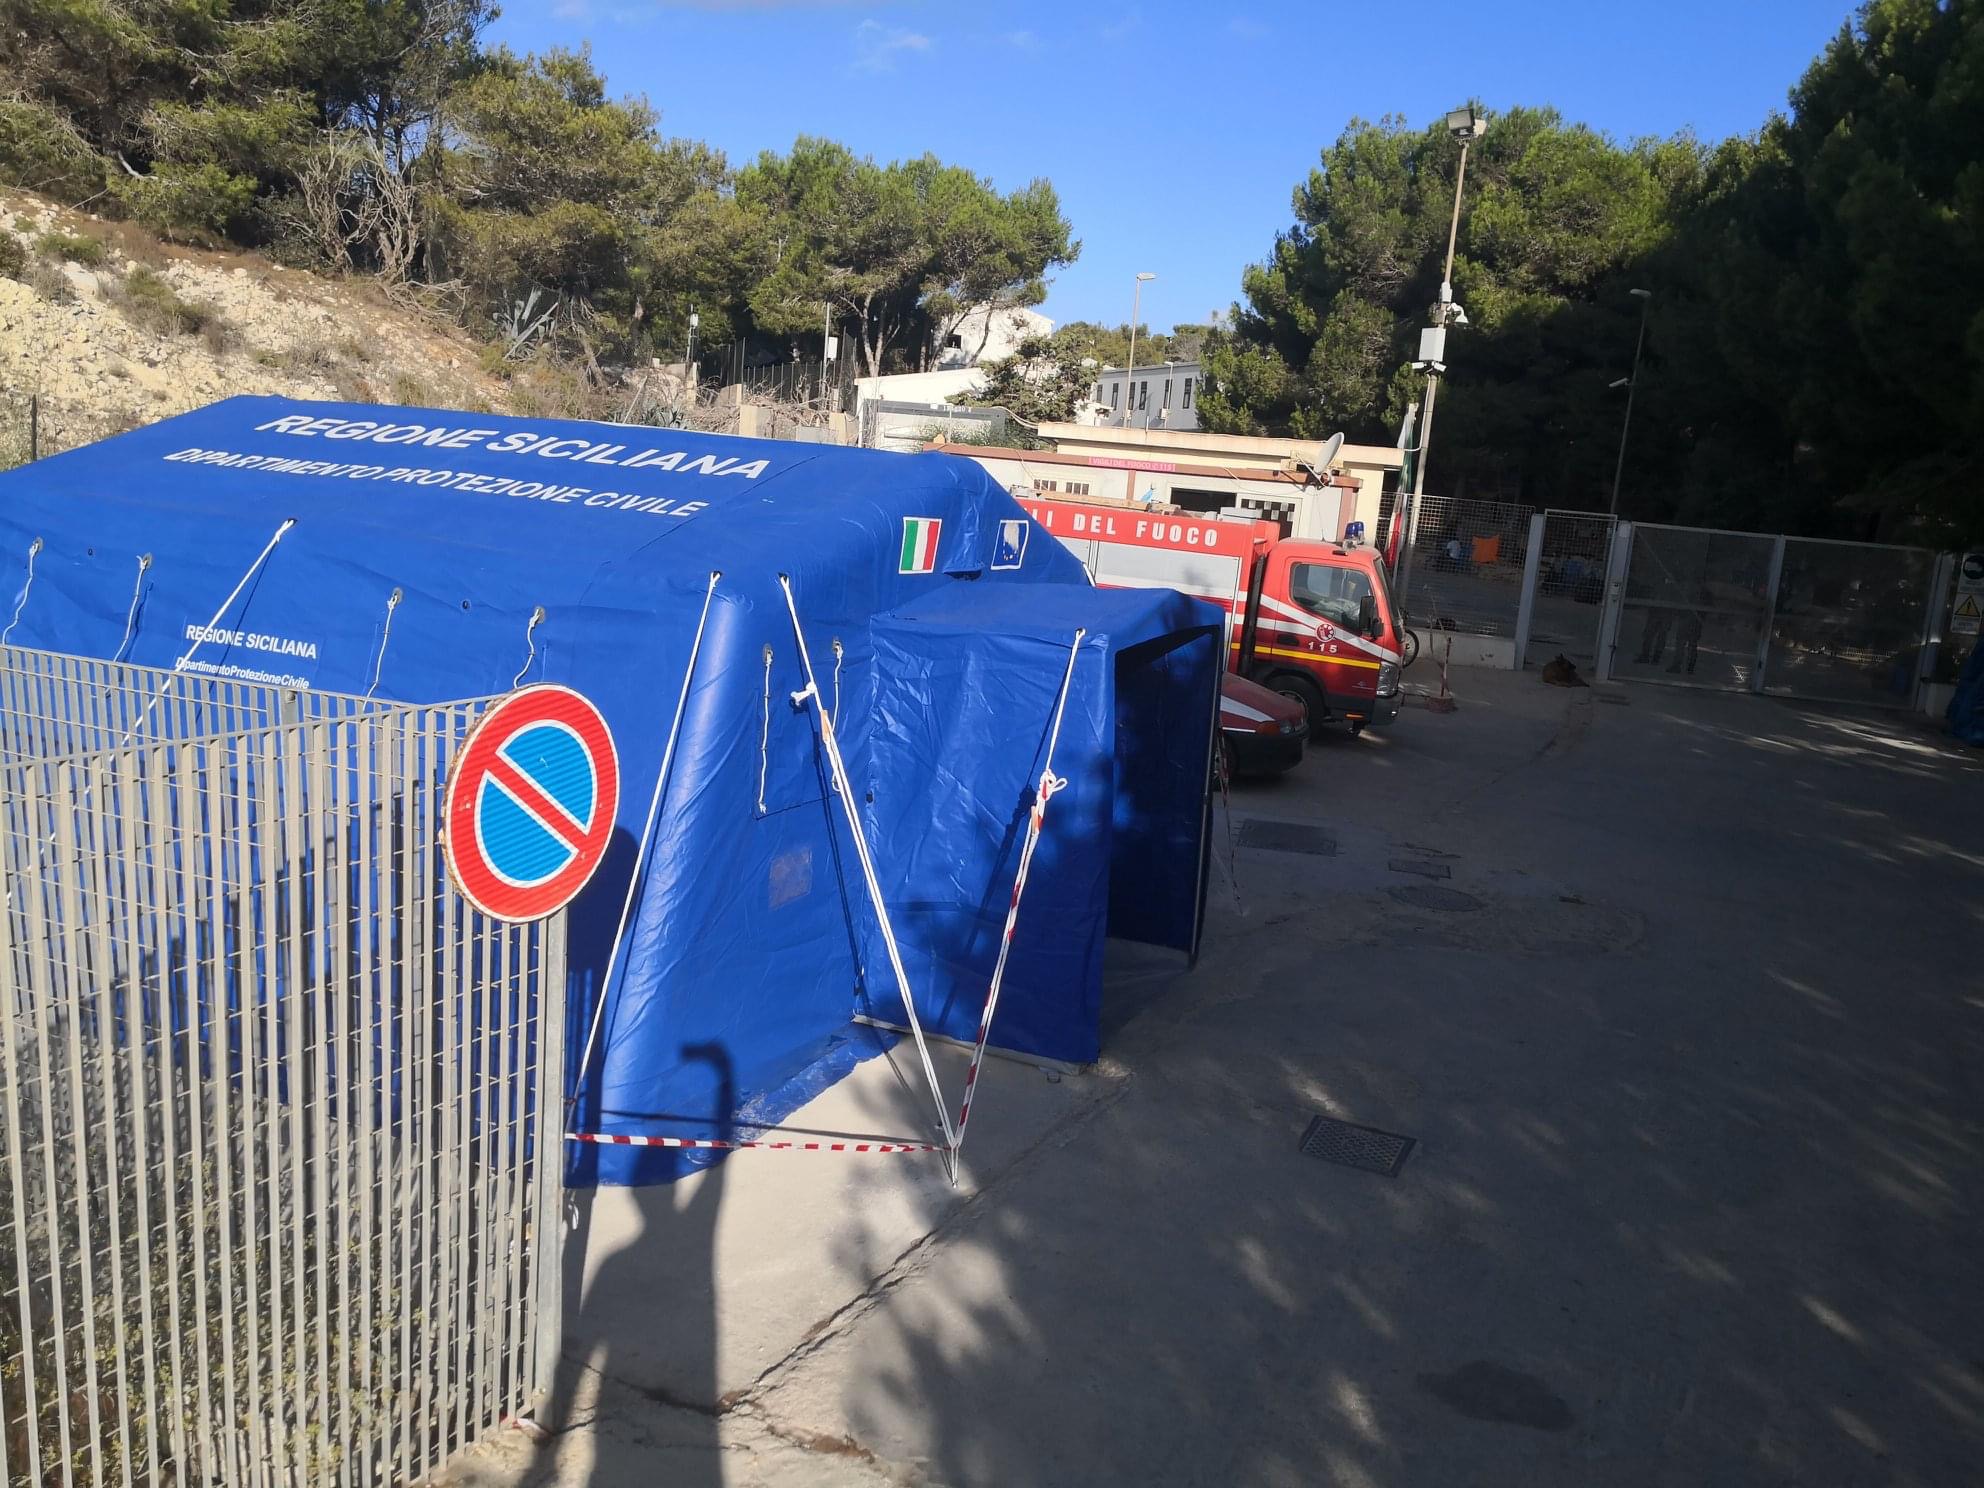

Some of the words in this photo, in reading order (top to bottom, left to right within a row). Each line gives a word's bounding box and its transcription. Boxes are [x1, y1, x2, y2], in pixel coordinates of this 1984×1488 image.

[254, 415, 499, 449] REGIONE
[486, 432, 770, 479] SICILIANA
[163, 448, 385, 480] DIPARTIMENTO
[373, 467, 592, 504] PROTEZIONE
[583, 492, 711, 517] CIVILE
[1073, 513, 1116, 535] DEL
[1136, 520, 1218, 547] FUOCO
[186, 624, 245, 646] REGIONE
[245, 633, 317, 659] SICILIANA
[1308, 641, 1338, 653] 115
